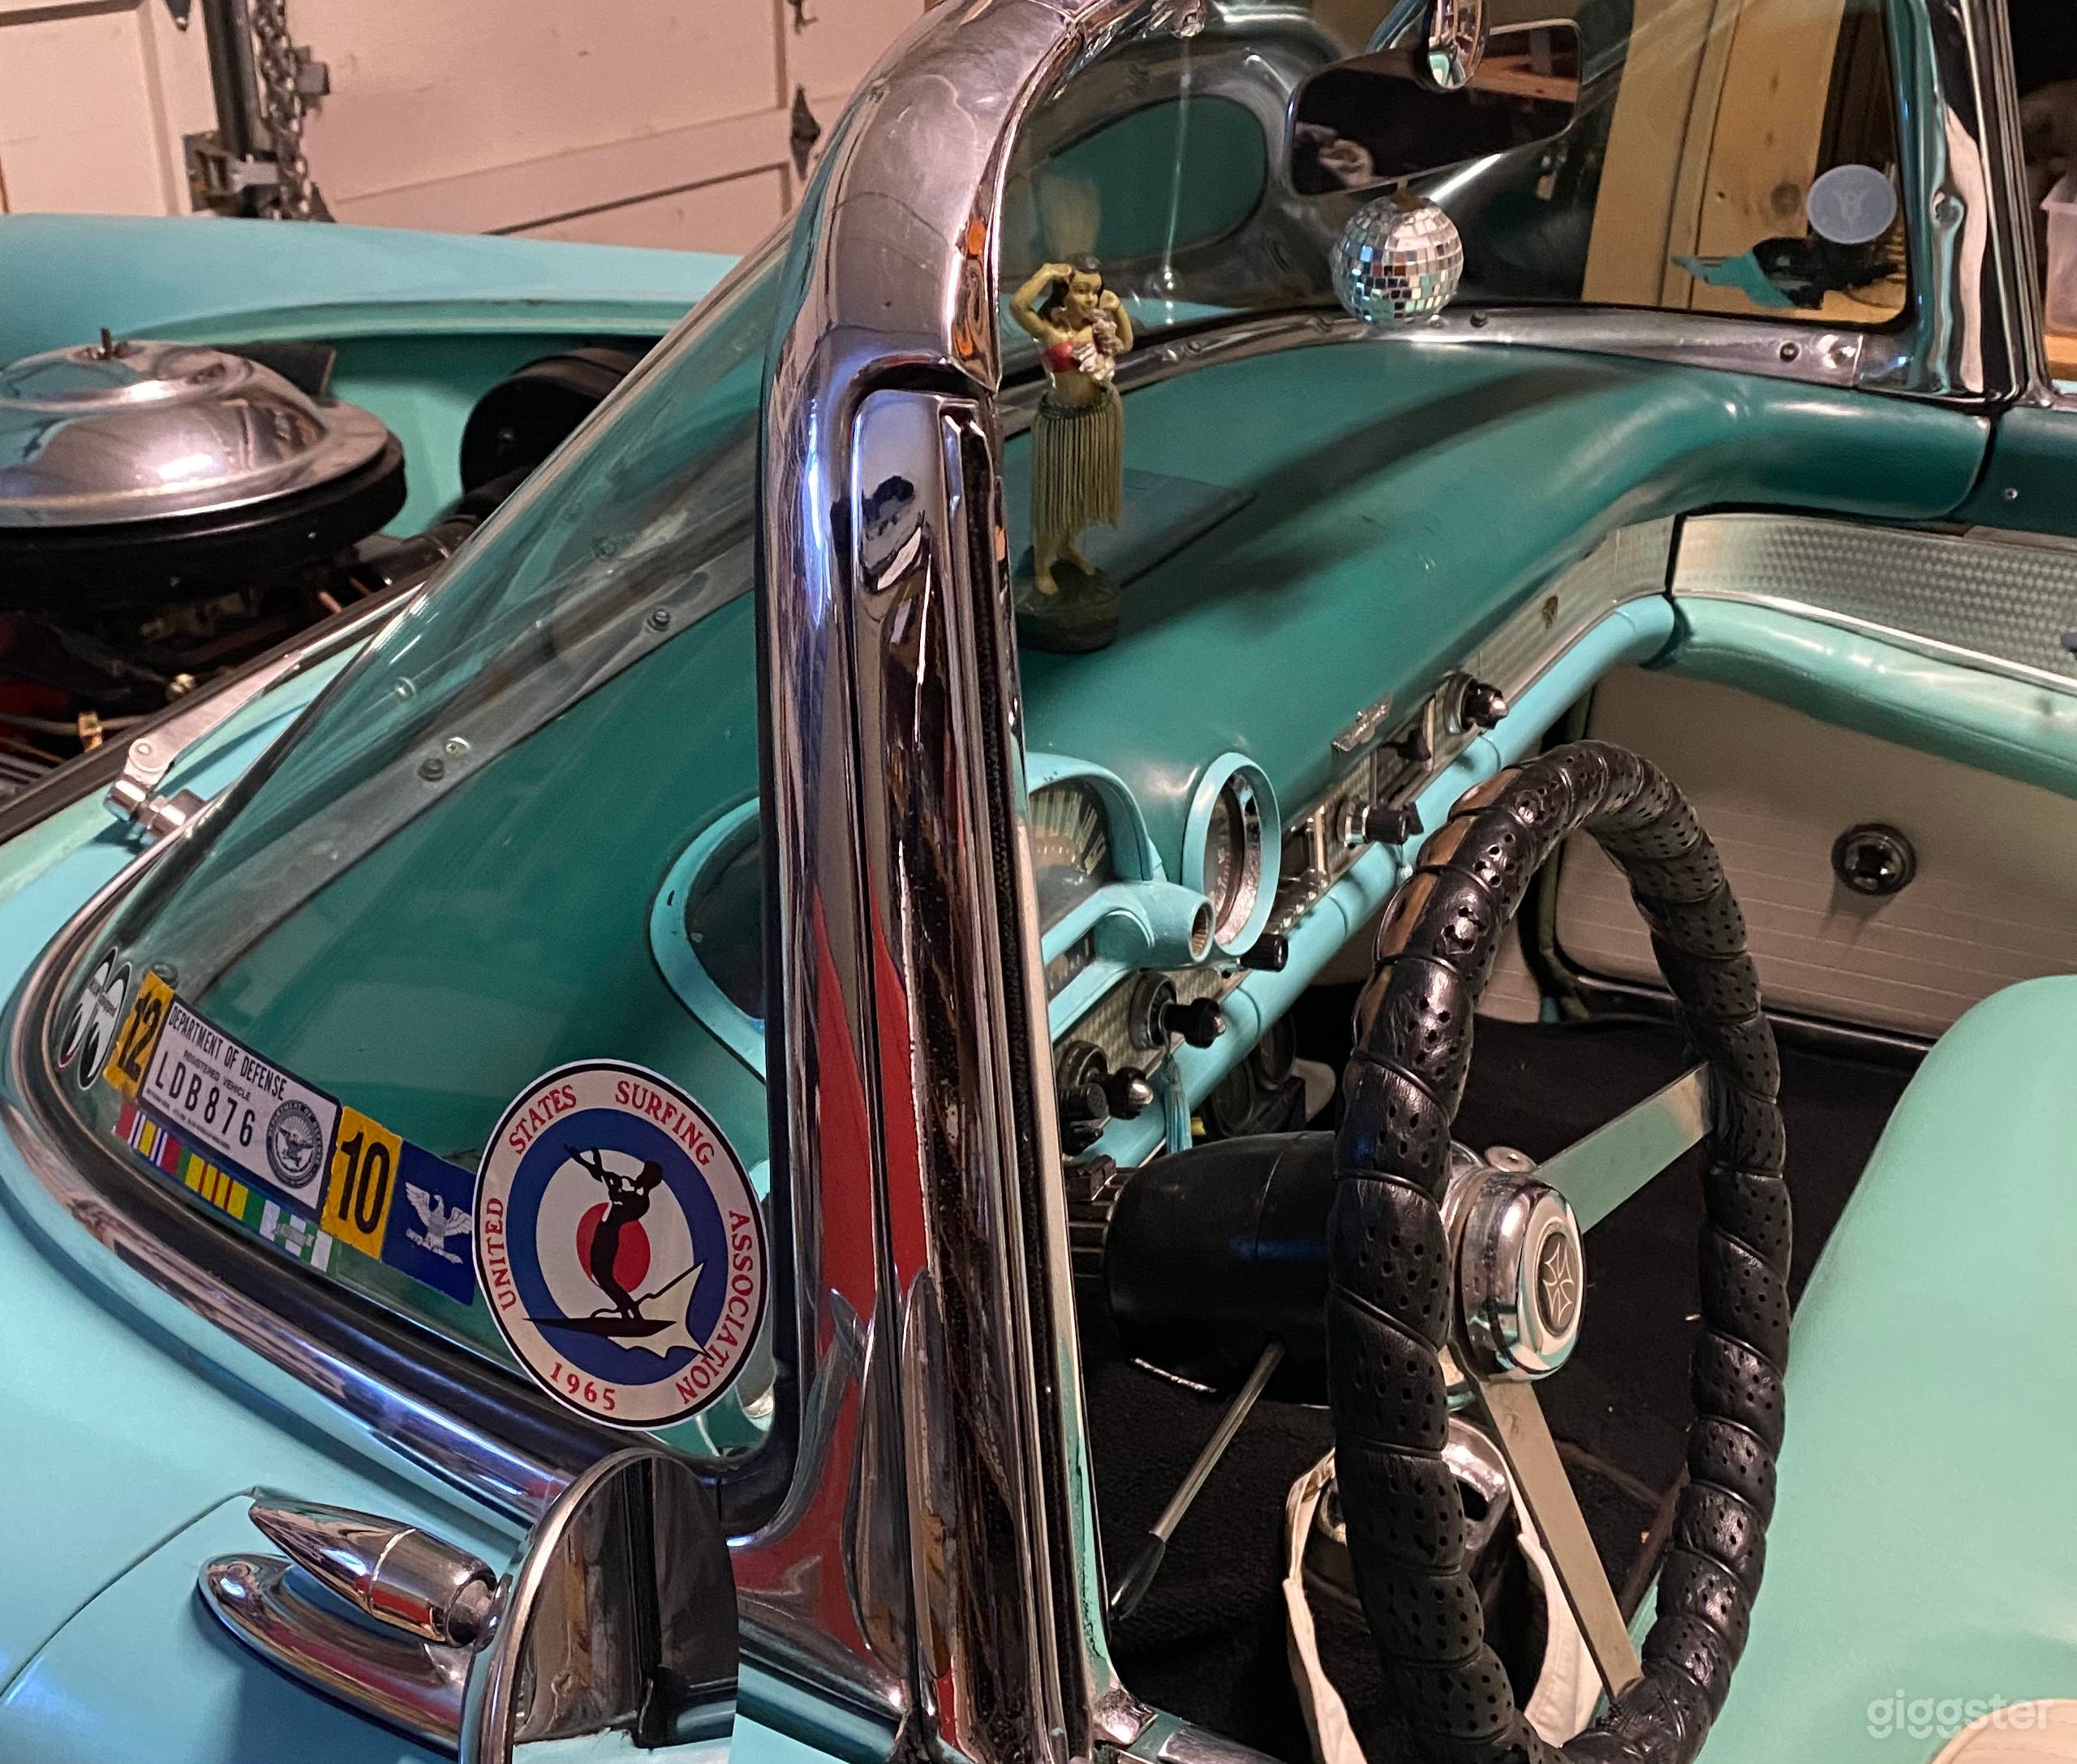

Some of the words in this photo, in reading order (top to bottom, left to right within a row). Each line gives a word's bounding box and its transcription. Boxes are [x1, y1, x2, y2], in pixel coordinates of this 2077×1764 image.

[116, 990, 162, 1083] 12
[168, 1005, 224, 1061] DEPARTMENT
[224, 1045, 239, 1069] OF
[240, 1056, 287, 1102] DEFENSE
[338, 1131, 391, 1235] 10
[486, 1197, 517, 1312] UNITED
[508, 1084, 578, 1155] STATES
[614, 1079, 716, 1167] SURFING
[675, 1209, 755, 1406] ASSOCIATION
[549, 1362, 617, 1412] 1965
